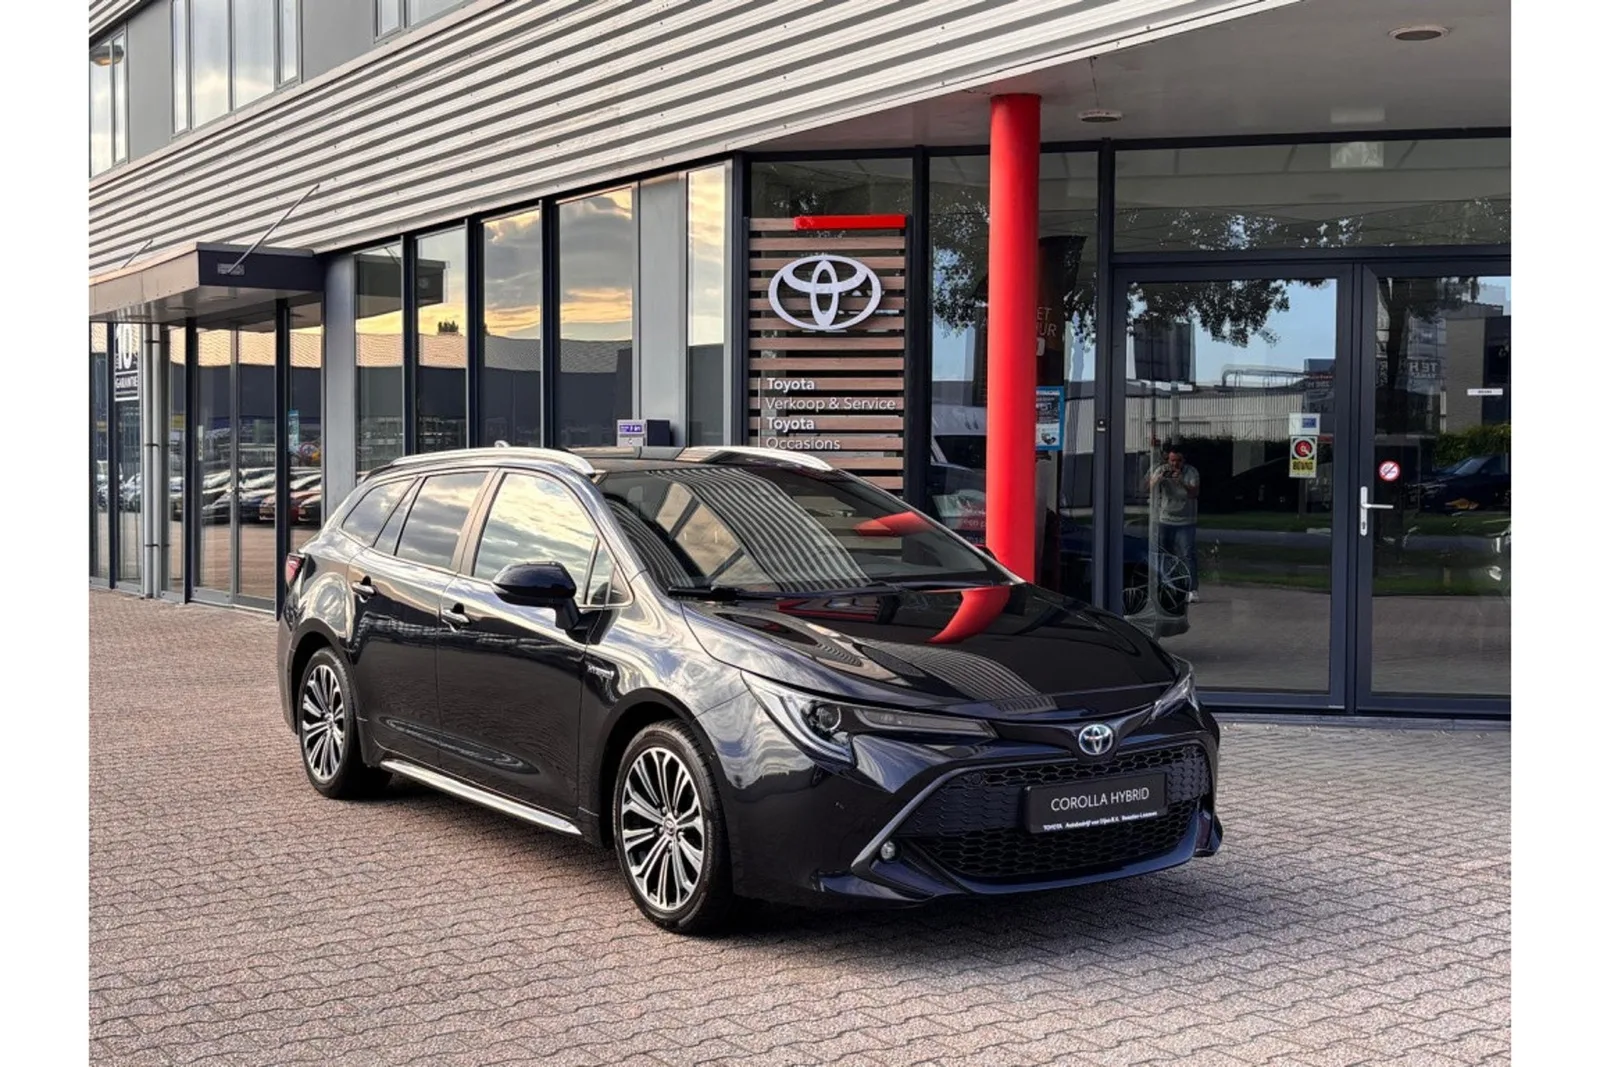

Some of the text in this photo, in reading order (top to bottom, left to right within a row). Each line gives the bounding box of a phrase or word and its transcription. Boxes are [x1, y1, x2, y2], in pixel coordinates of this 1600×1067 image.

[766, 377, 815, 393] Toyota
[765, 396, 897, 412] Verkoop & Service
[766, 416, 815, 432] Toyota
[765, 436, 841, 450] Occasions
[1050, 787, 1150, 811] COROLLA HYBRID
